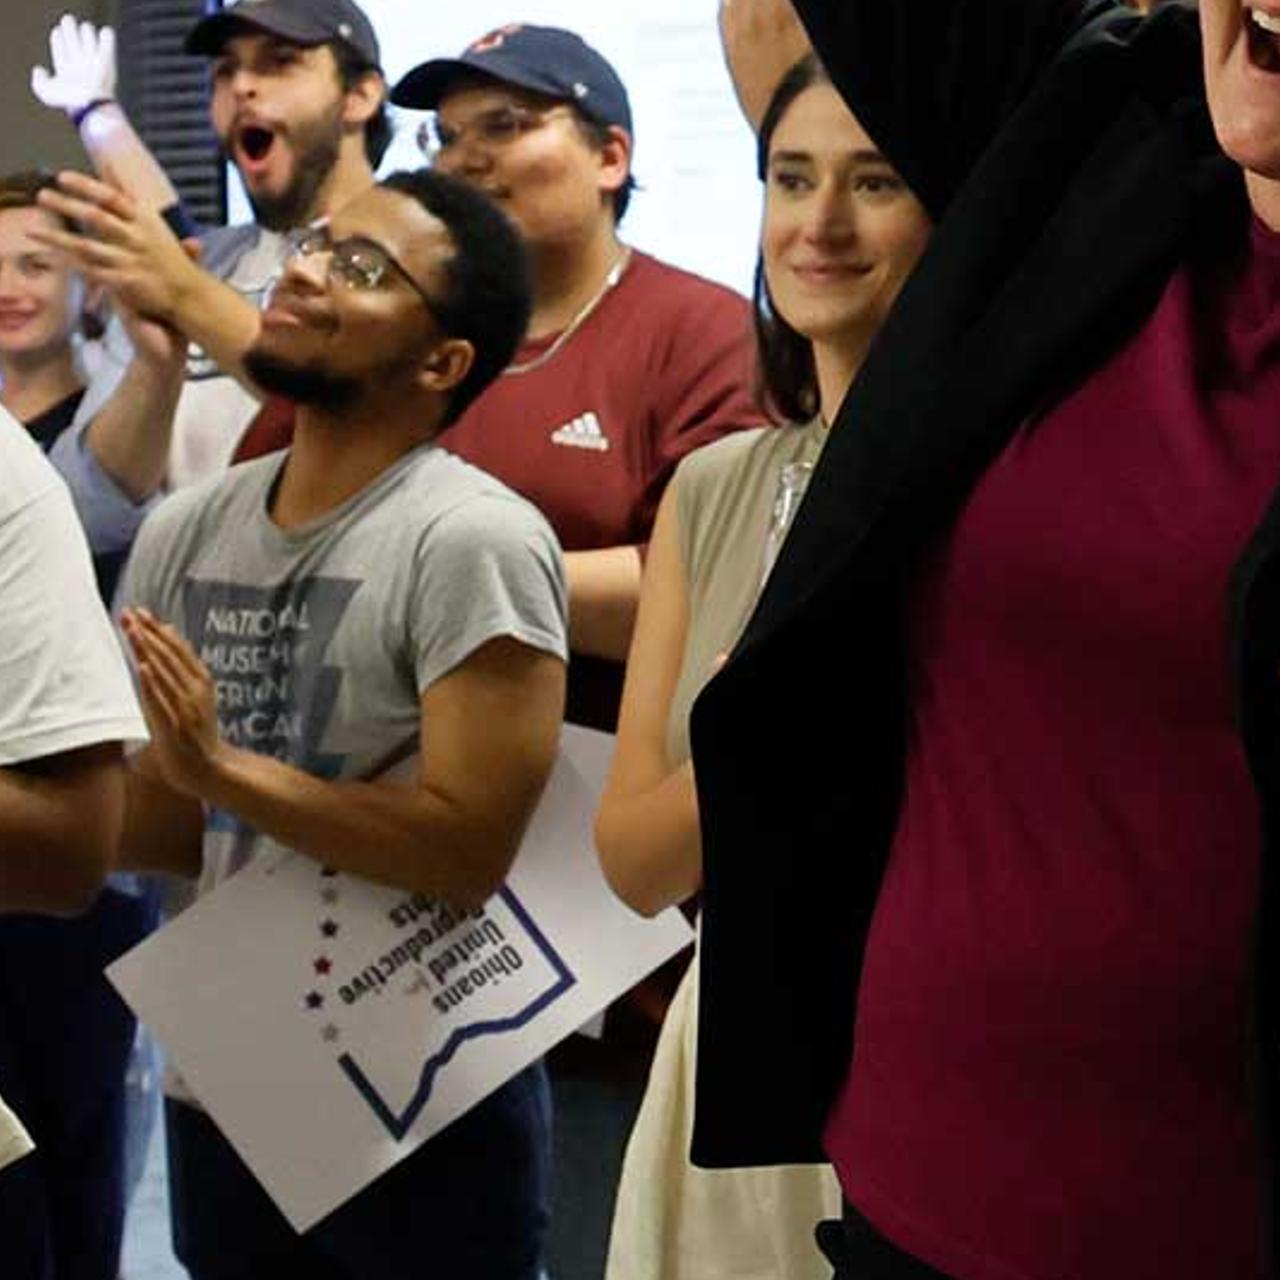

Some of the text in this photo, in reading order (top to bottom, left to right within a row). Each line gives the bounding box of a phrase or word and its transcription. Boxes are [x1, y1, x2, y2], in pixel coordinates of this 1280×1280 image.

[204, 601, 310, 638] NATIOAL
[200, 639, 291, 675] MUSEM
[428, 918, 506, 986] United
[431, 944, 524, 1014] Ohioans
